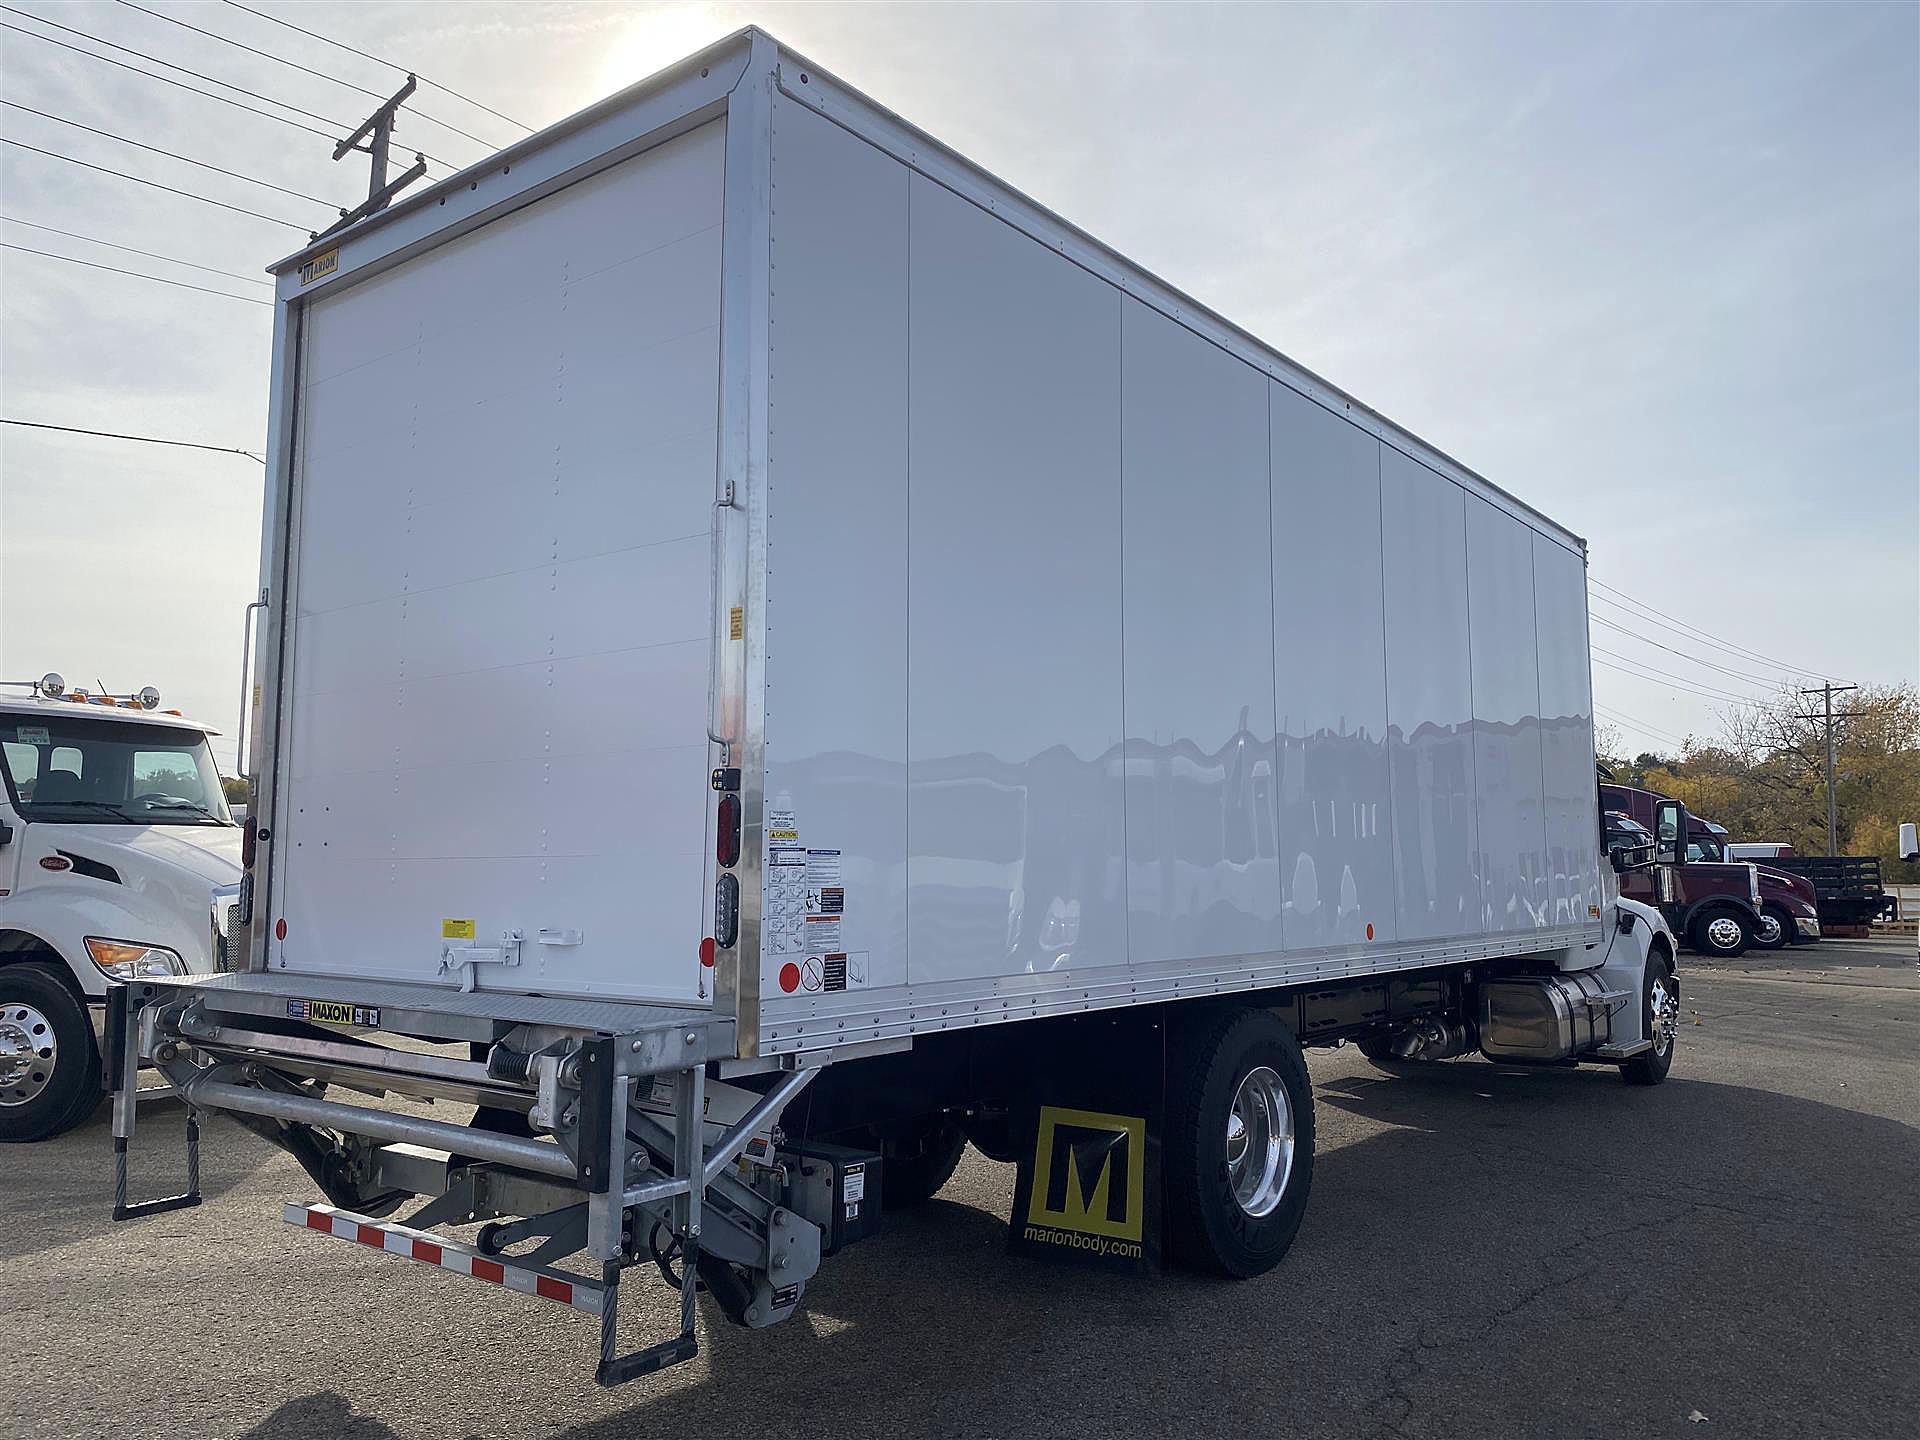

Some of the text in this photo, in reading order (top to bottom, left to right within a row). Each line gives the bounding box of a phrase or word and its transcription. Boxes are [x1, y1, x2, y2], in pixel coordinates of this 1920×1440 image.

[303, 254, 336, 283] MARION
[312, 1002, 351, 1022] MAXON
[1024, 1226, 1142, 1258] marionbody.com
